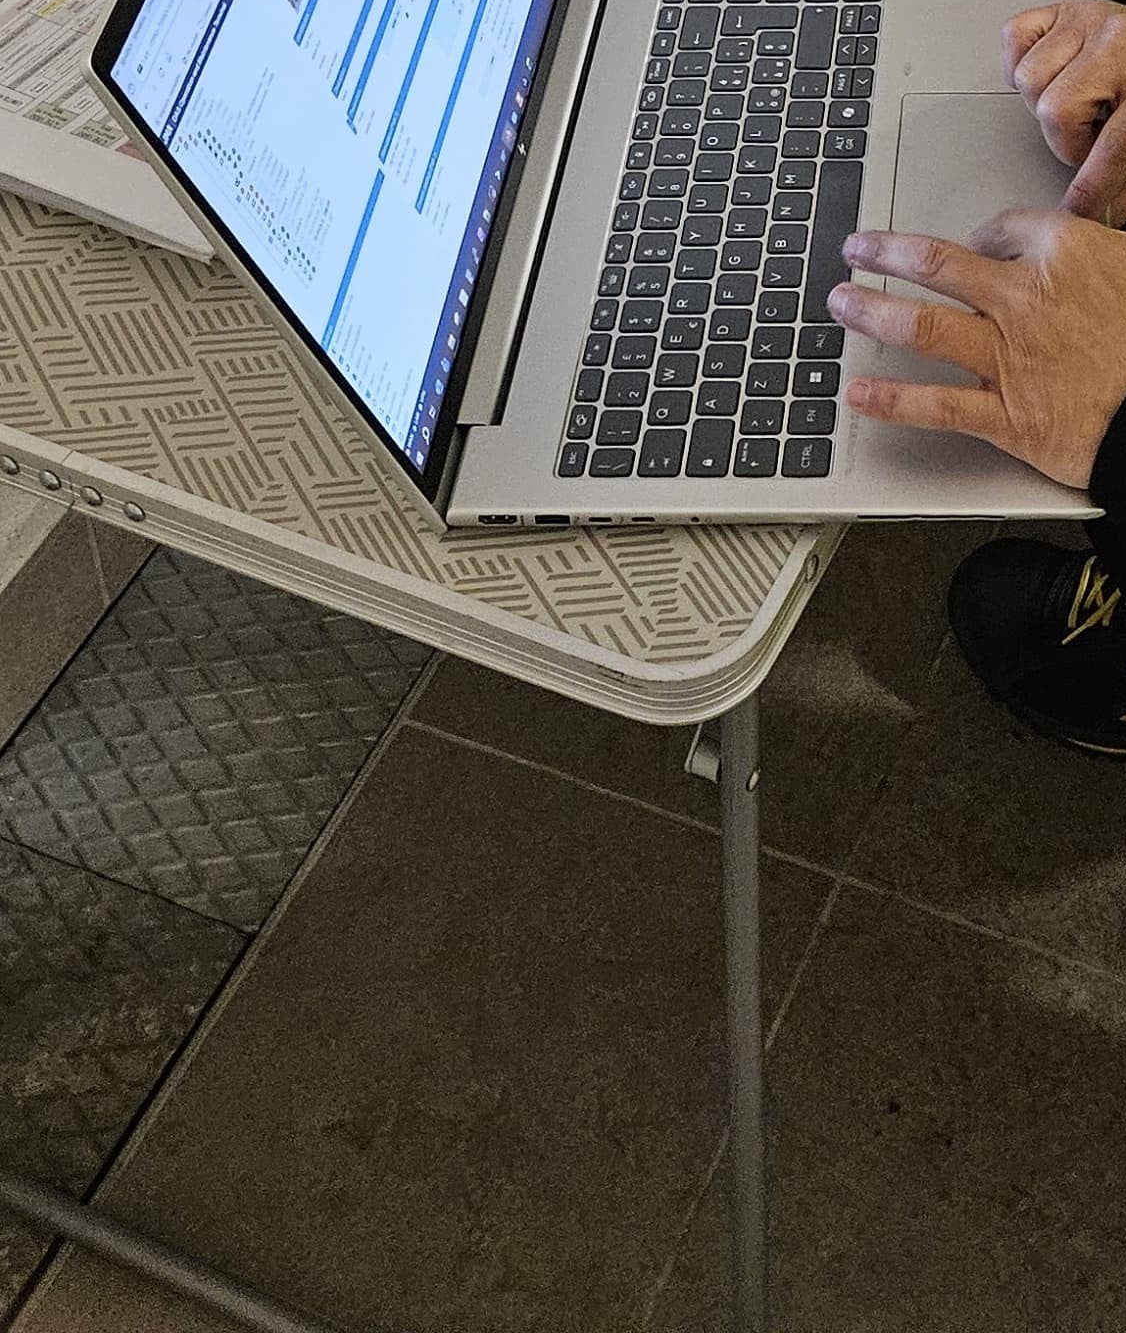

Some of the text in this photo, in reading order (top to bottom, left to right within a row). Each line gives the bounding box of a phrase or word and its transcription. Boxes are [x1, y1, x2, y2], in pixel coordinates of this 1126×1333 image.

[712, 107, 723, 115] P
[707, 136, 719, 146] O
[745, 160, 757, 168] K
[785, 174, 797, 184] M
[695, 199, 707, 208] U
[780, 206, 792, 215] N
[734, 223, 746, 232] H
[690, 231, 701, 240] Y
[775, 240, 787, 248] B
[729, 255, 741, 266] G
[682, 265, 694, 273] T
[770, 273, 782, 282] V
[723, 290, 734, 299] F
[676, 299, 689, 308] R
[765, 308, 777, 317] C
[716, 325, 729, 335] D
[670, 335, 683, 343] E
[760, 343, 772, 352] X
[710, 361, 723, 370] S
[662, 368, 675, 381] W
[754, 380, 767, 389] Z
[705, 398, 718, 409] A
[655, 408, 669, 419] Q
[800, 444, 813, 469] CTRL
